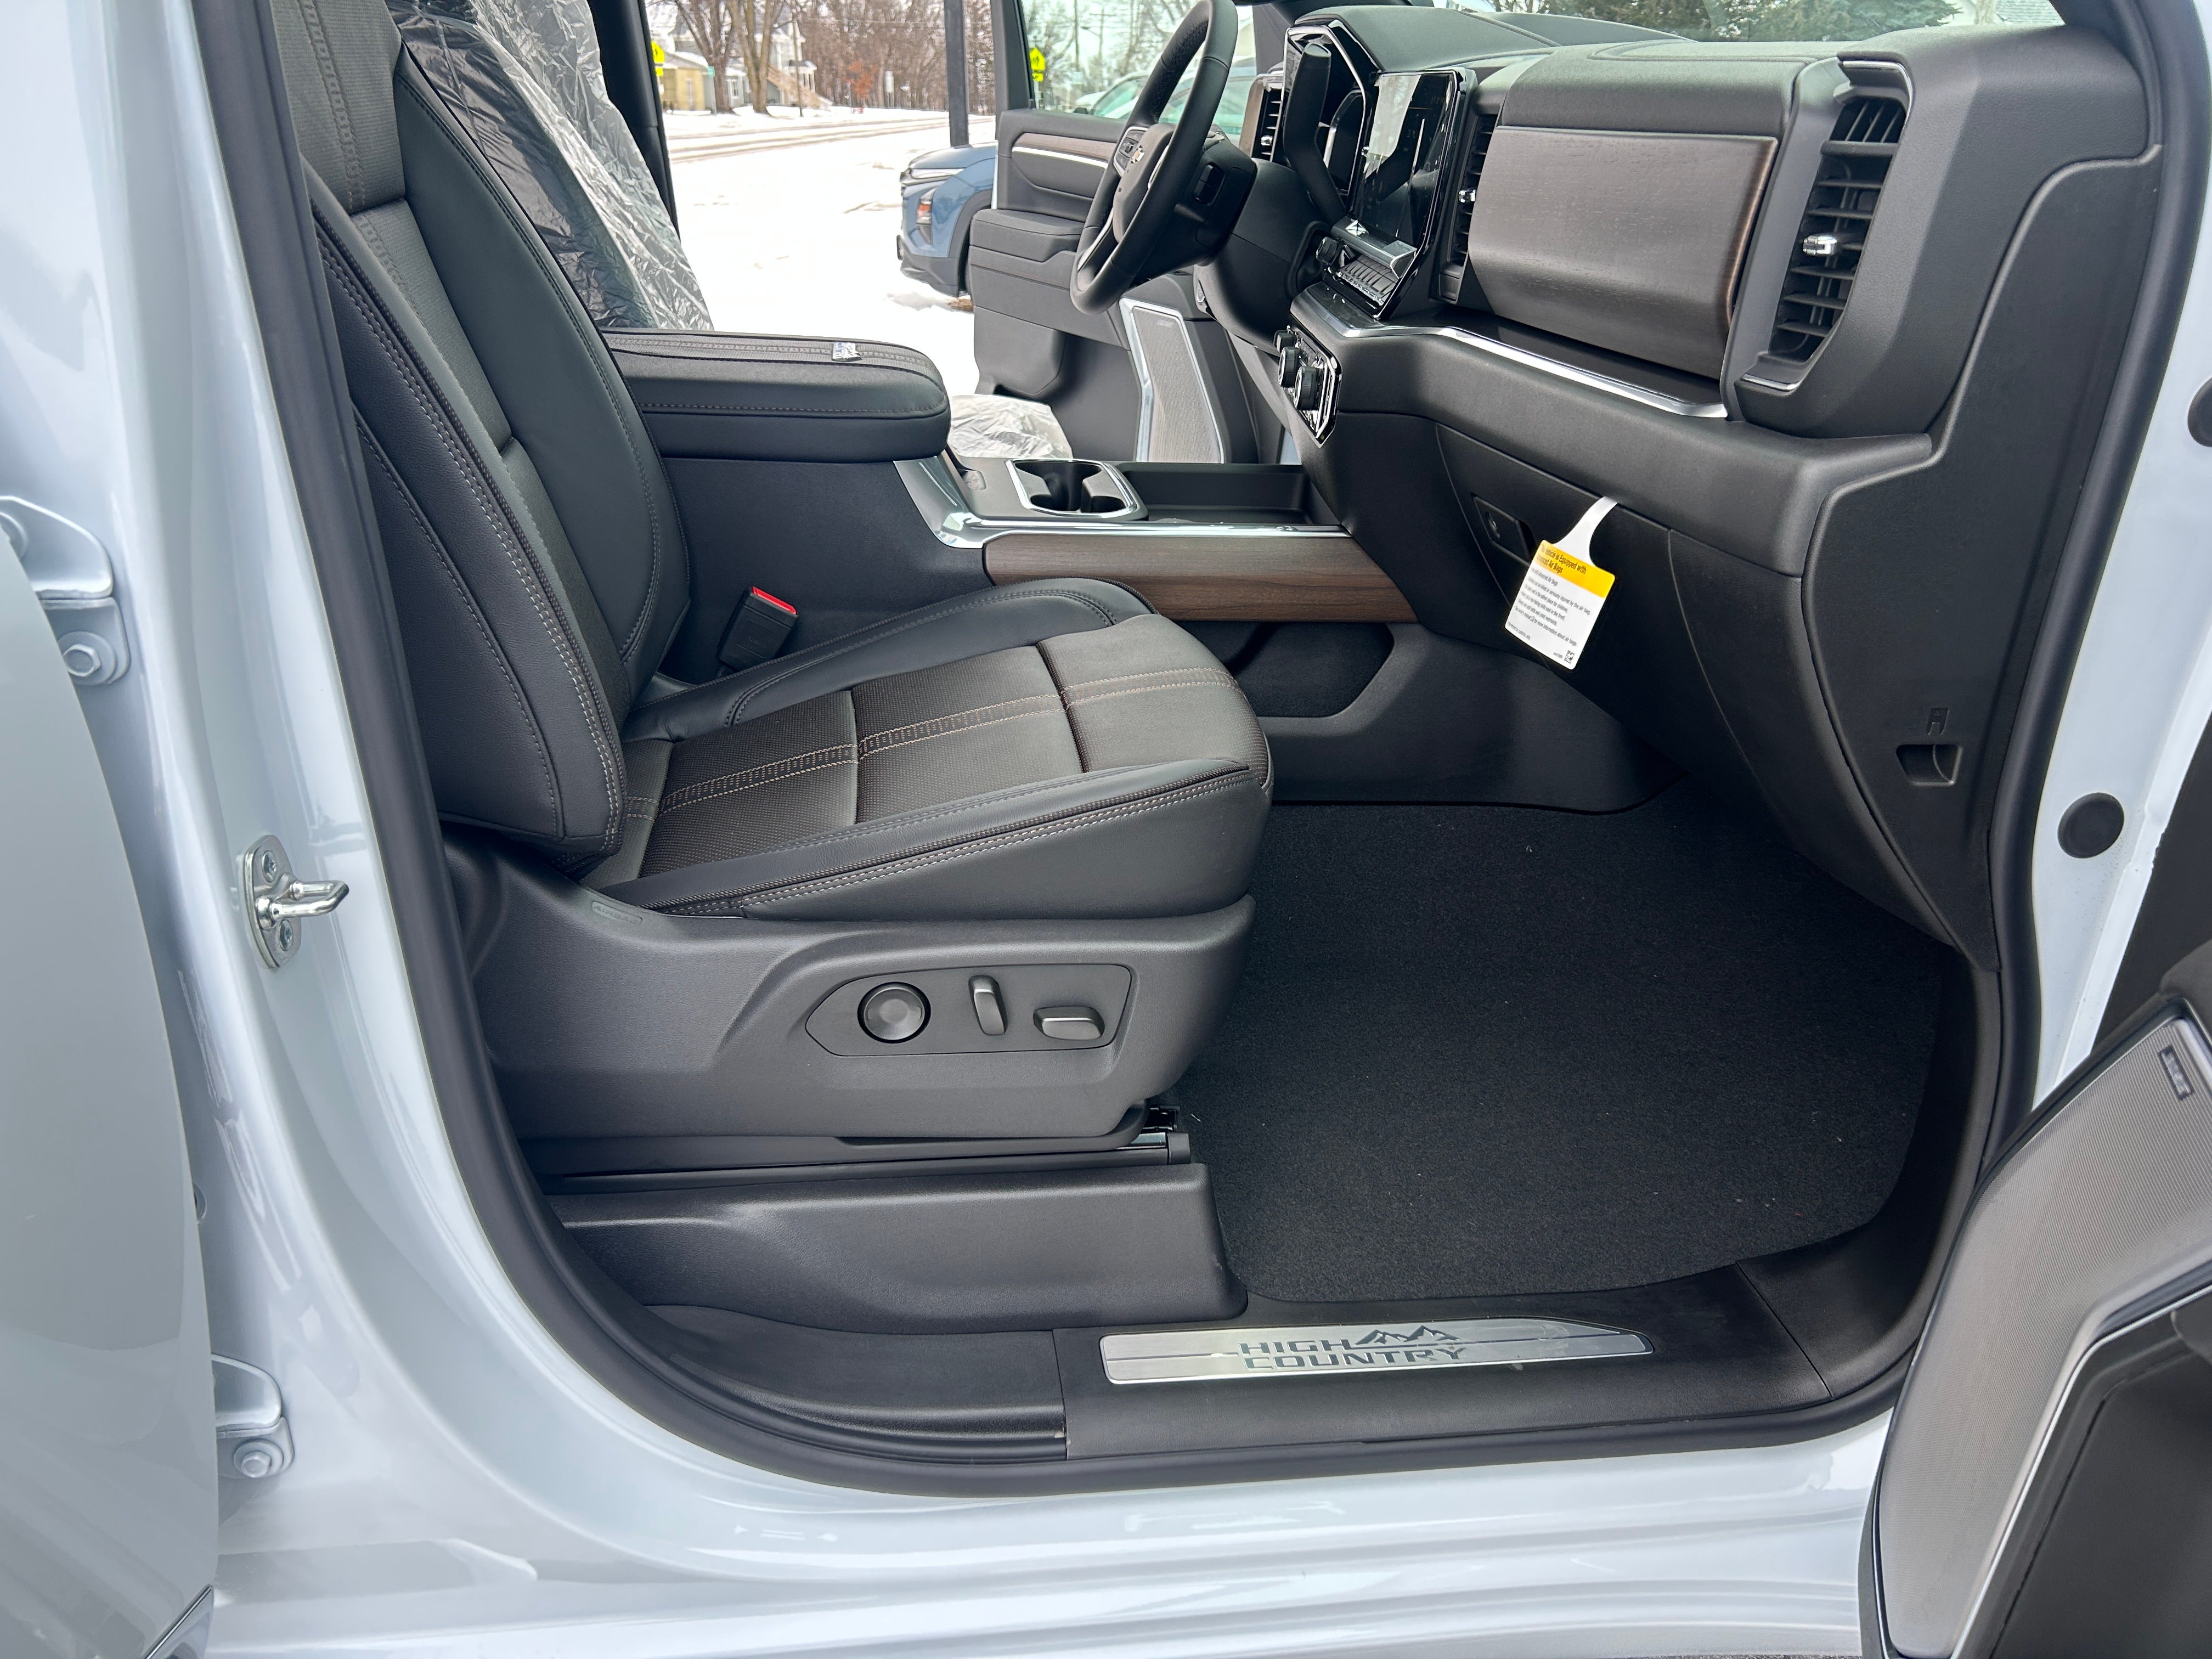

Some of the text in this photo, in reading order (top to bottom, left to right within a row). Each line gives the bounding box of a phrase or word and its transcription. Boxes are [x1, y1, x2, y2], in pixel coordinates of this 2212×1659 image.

[1552, 562, 1564, 574] Bags
[1558, 555, 1577, 571] Equipped
[1576, 563, 1587, 574] with
[594, 905, 640, 925] AIRBAG
[1239, 1339, 1352, 1356] HIGH
[1244, 1347, 1466, 1369] COUNTRY
